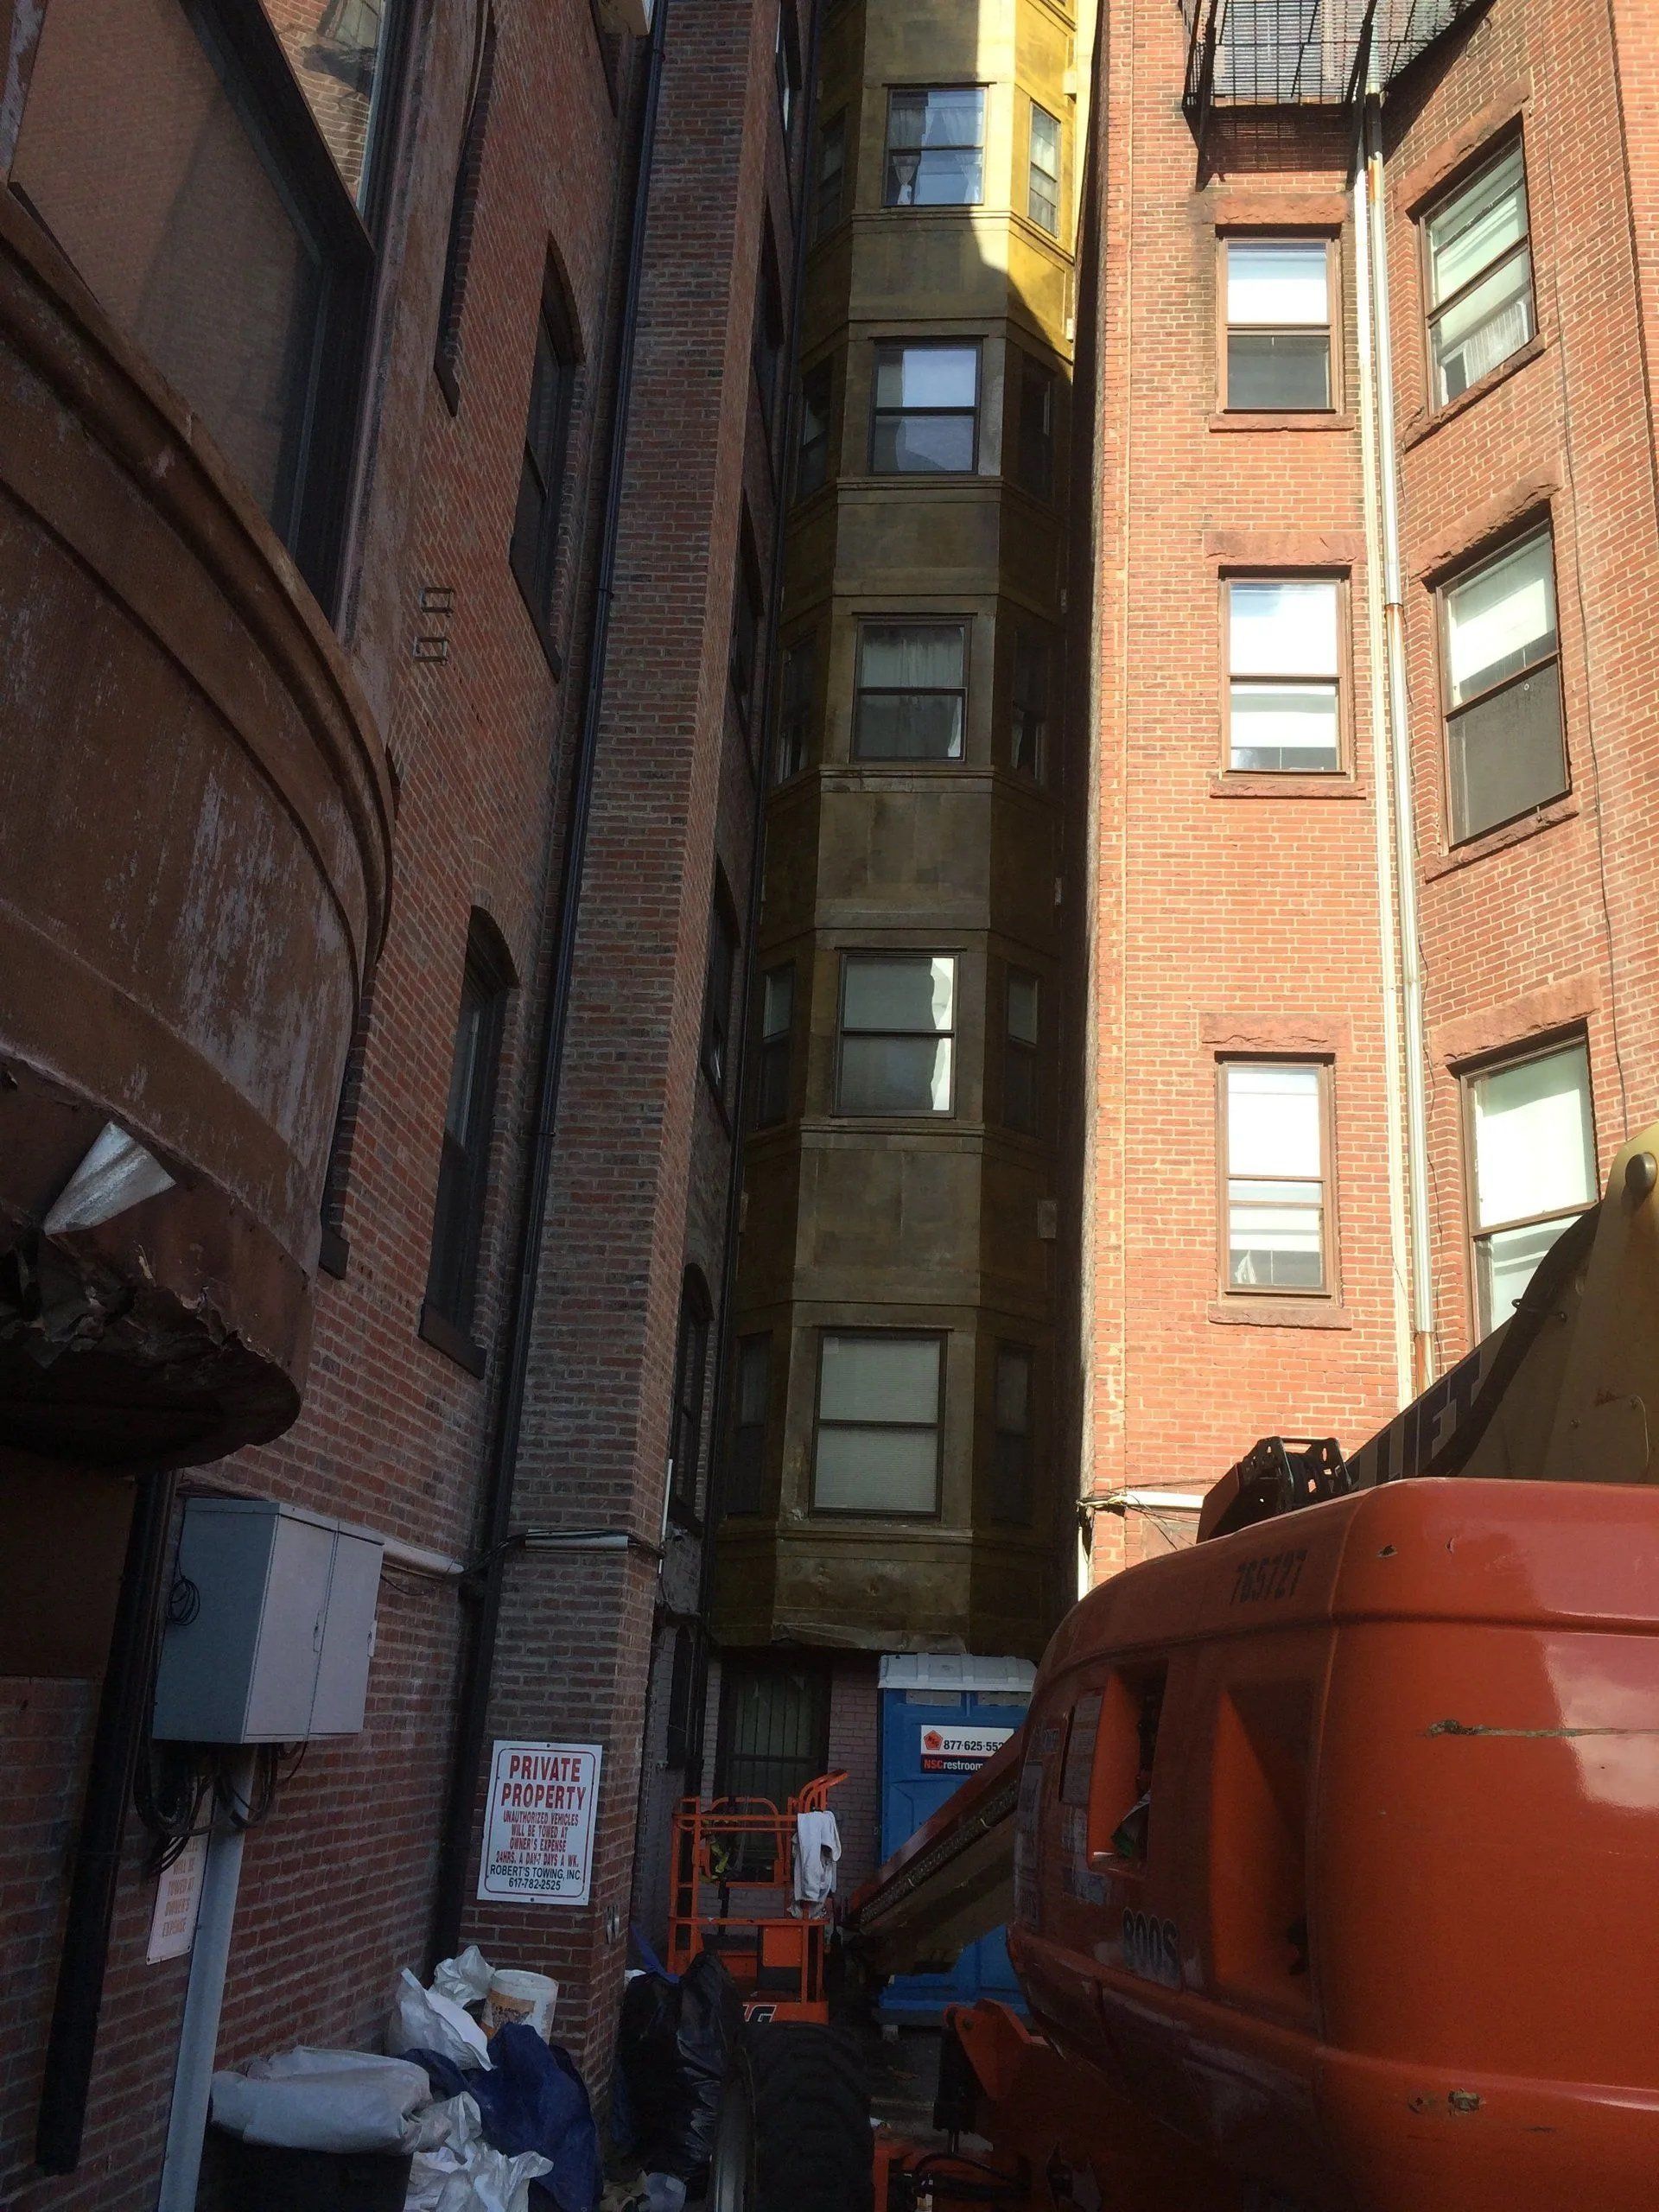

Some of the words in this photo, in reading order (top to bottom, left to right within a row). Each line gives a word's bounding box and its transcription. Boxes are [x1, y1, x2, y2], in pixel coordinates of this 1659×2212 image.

[509, 1755, 582, 1783] PRIVATE
[501, 1783, 587, 1810] PROPERTY
[503, 1809, 549, 1825] UNAUTHORIZED
[550, 1812, 579, 1827] VEHICLES
[512, 1823, 525, 1837] WILL
[527, 1824, 537, 1838] BE
[538, 1825, 558, 1839] TOWED
[560, 1827, 569, 1839] AT
[510, 1837, 537, 1851] OWNER'S
[540, 1839, 567, 1853] EXPENSE
[518, 1853, 524, 1865] A
[543, 1853, 558, 1866] DAYS
[560, 1855, 565, 1867] A
[490, 1865, 531, 1878] ROBERT'S
[532, 1867, 564, 1882] TOWING,
[508, 1877, 562, 1891] 617-782-2525
